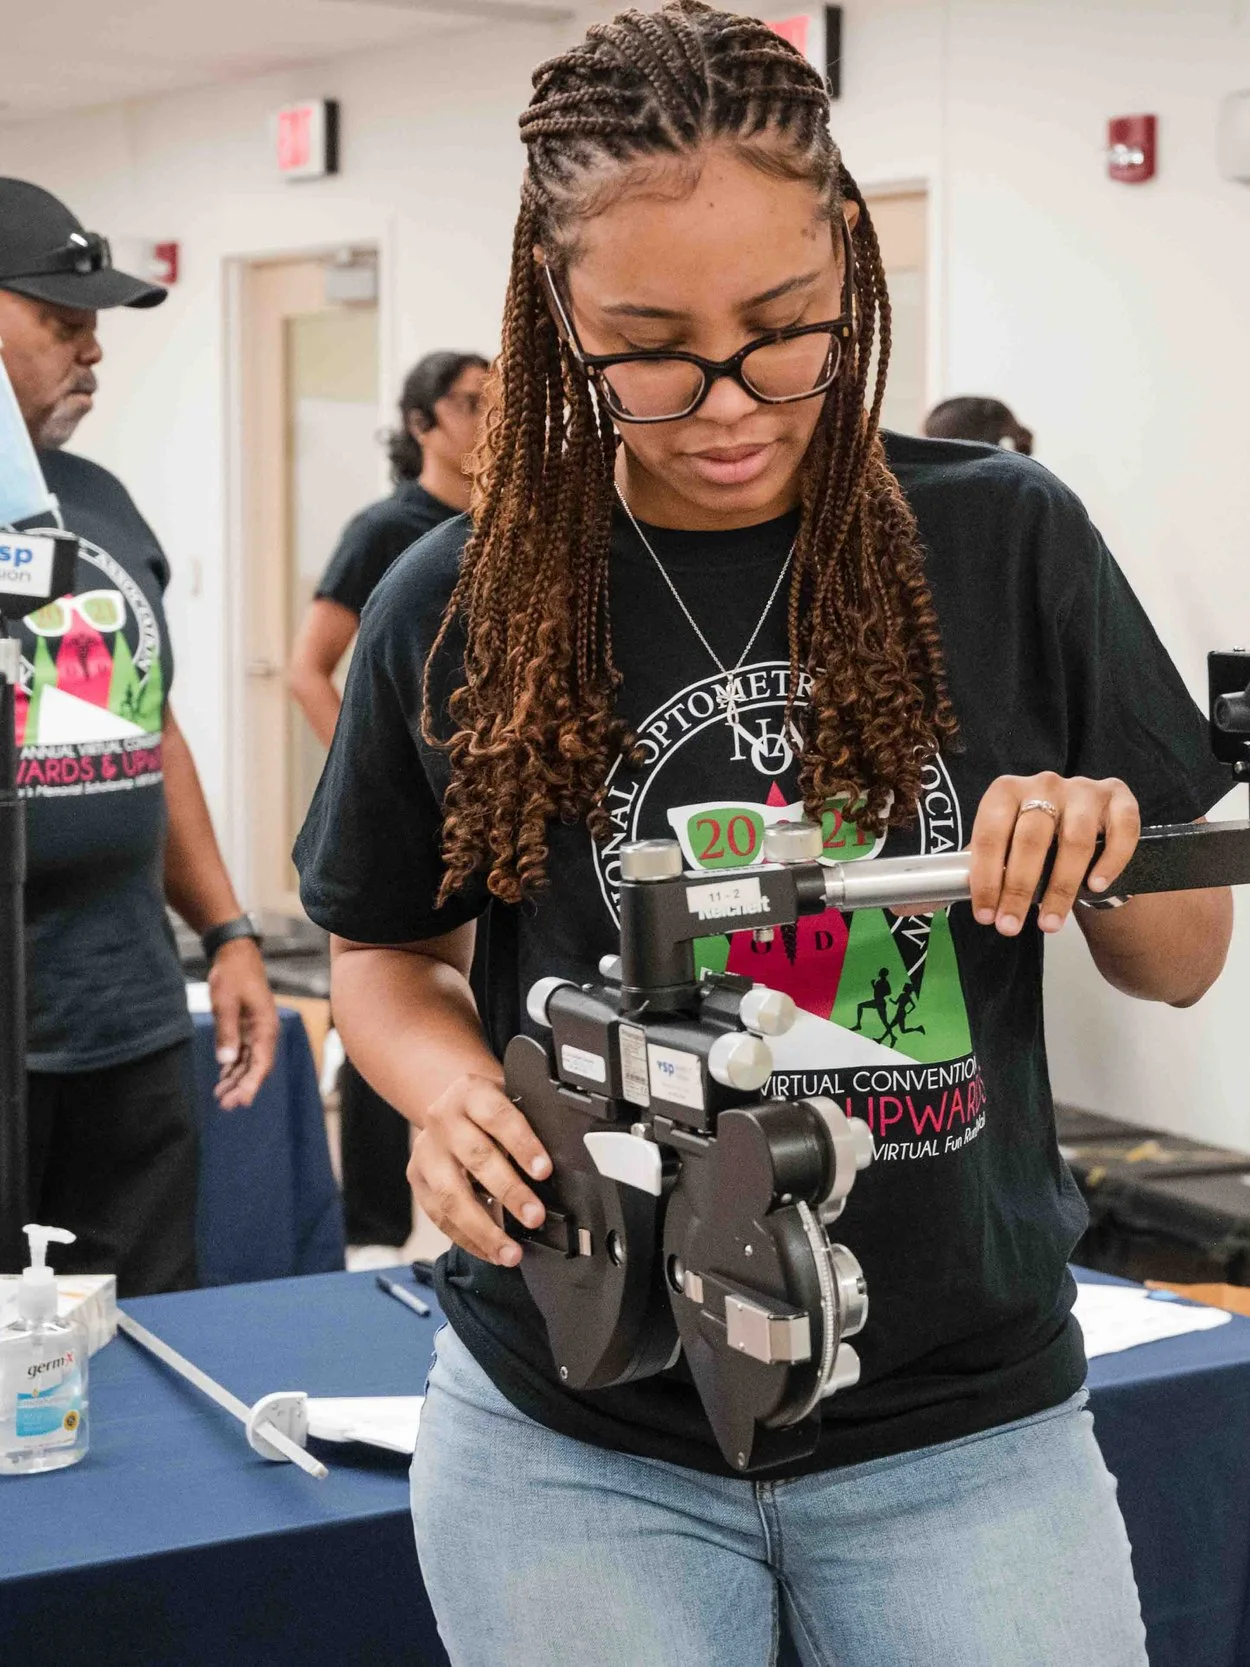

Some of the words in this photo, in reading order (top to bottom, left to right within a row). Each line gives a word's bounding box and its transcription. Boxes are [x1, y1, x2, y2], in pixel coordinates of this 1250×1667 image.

[0, 545, 33, 567] sp
[633, 669, 815, 765] OPTOMETR
[16, 755, 95, 785] ARDS
[696, 814, 758, 861] 20
[814, 930, 834, 951] D
[760, 1073, 845, 1097] VIRTUAL
[872, 1139, 940, 1162] VIRTUAL
[944, 1135, 963, 1154] Fun
